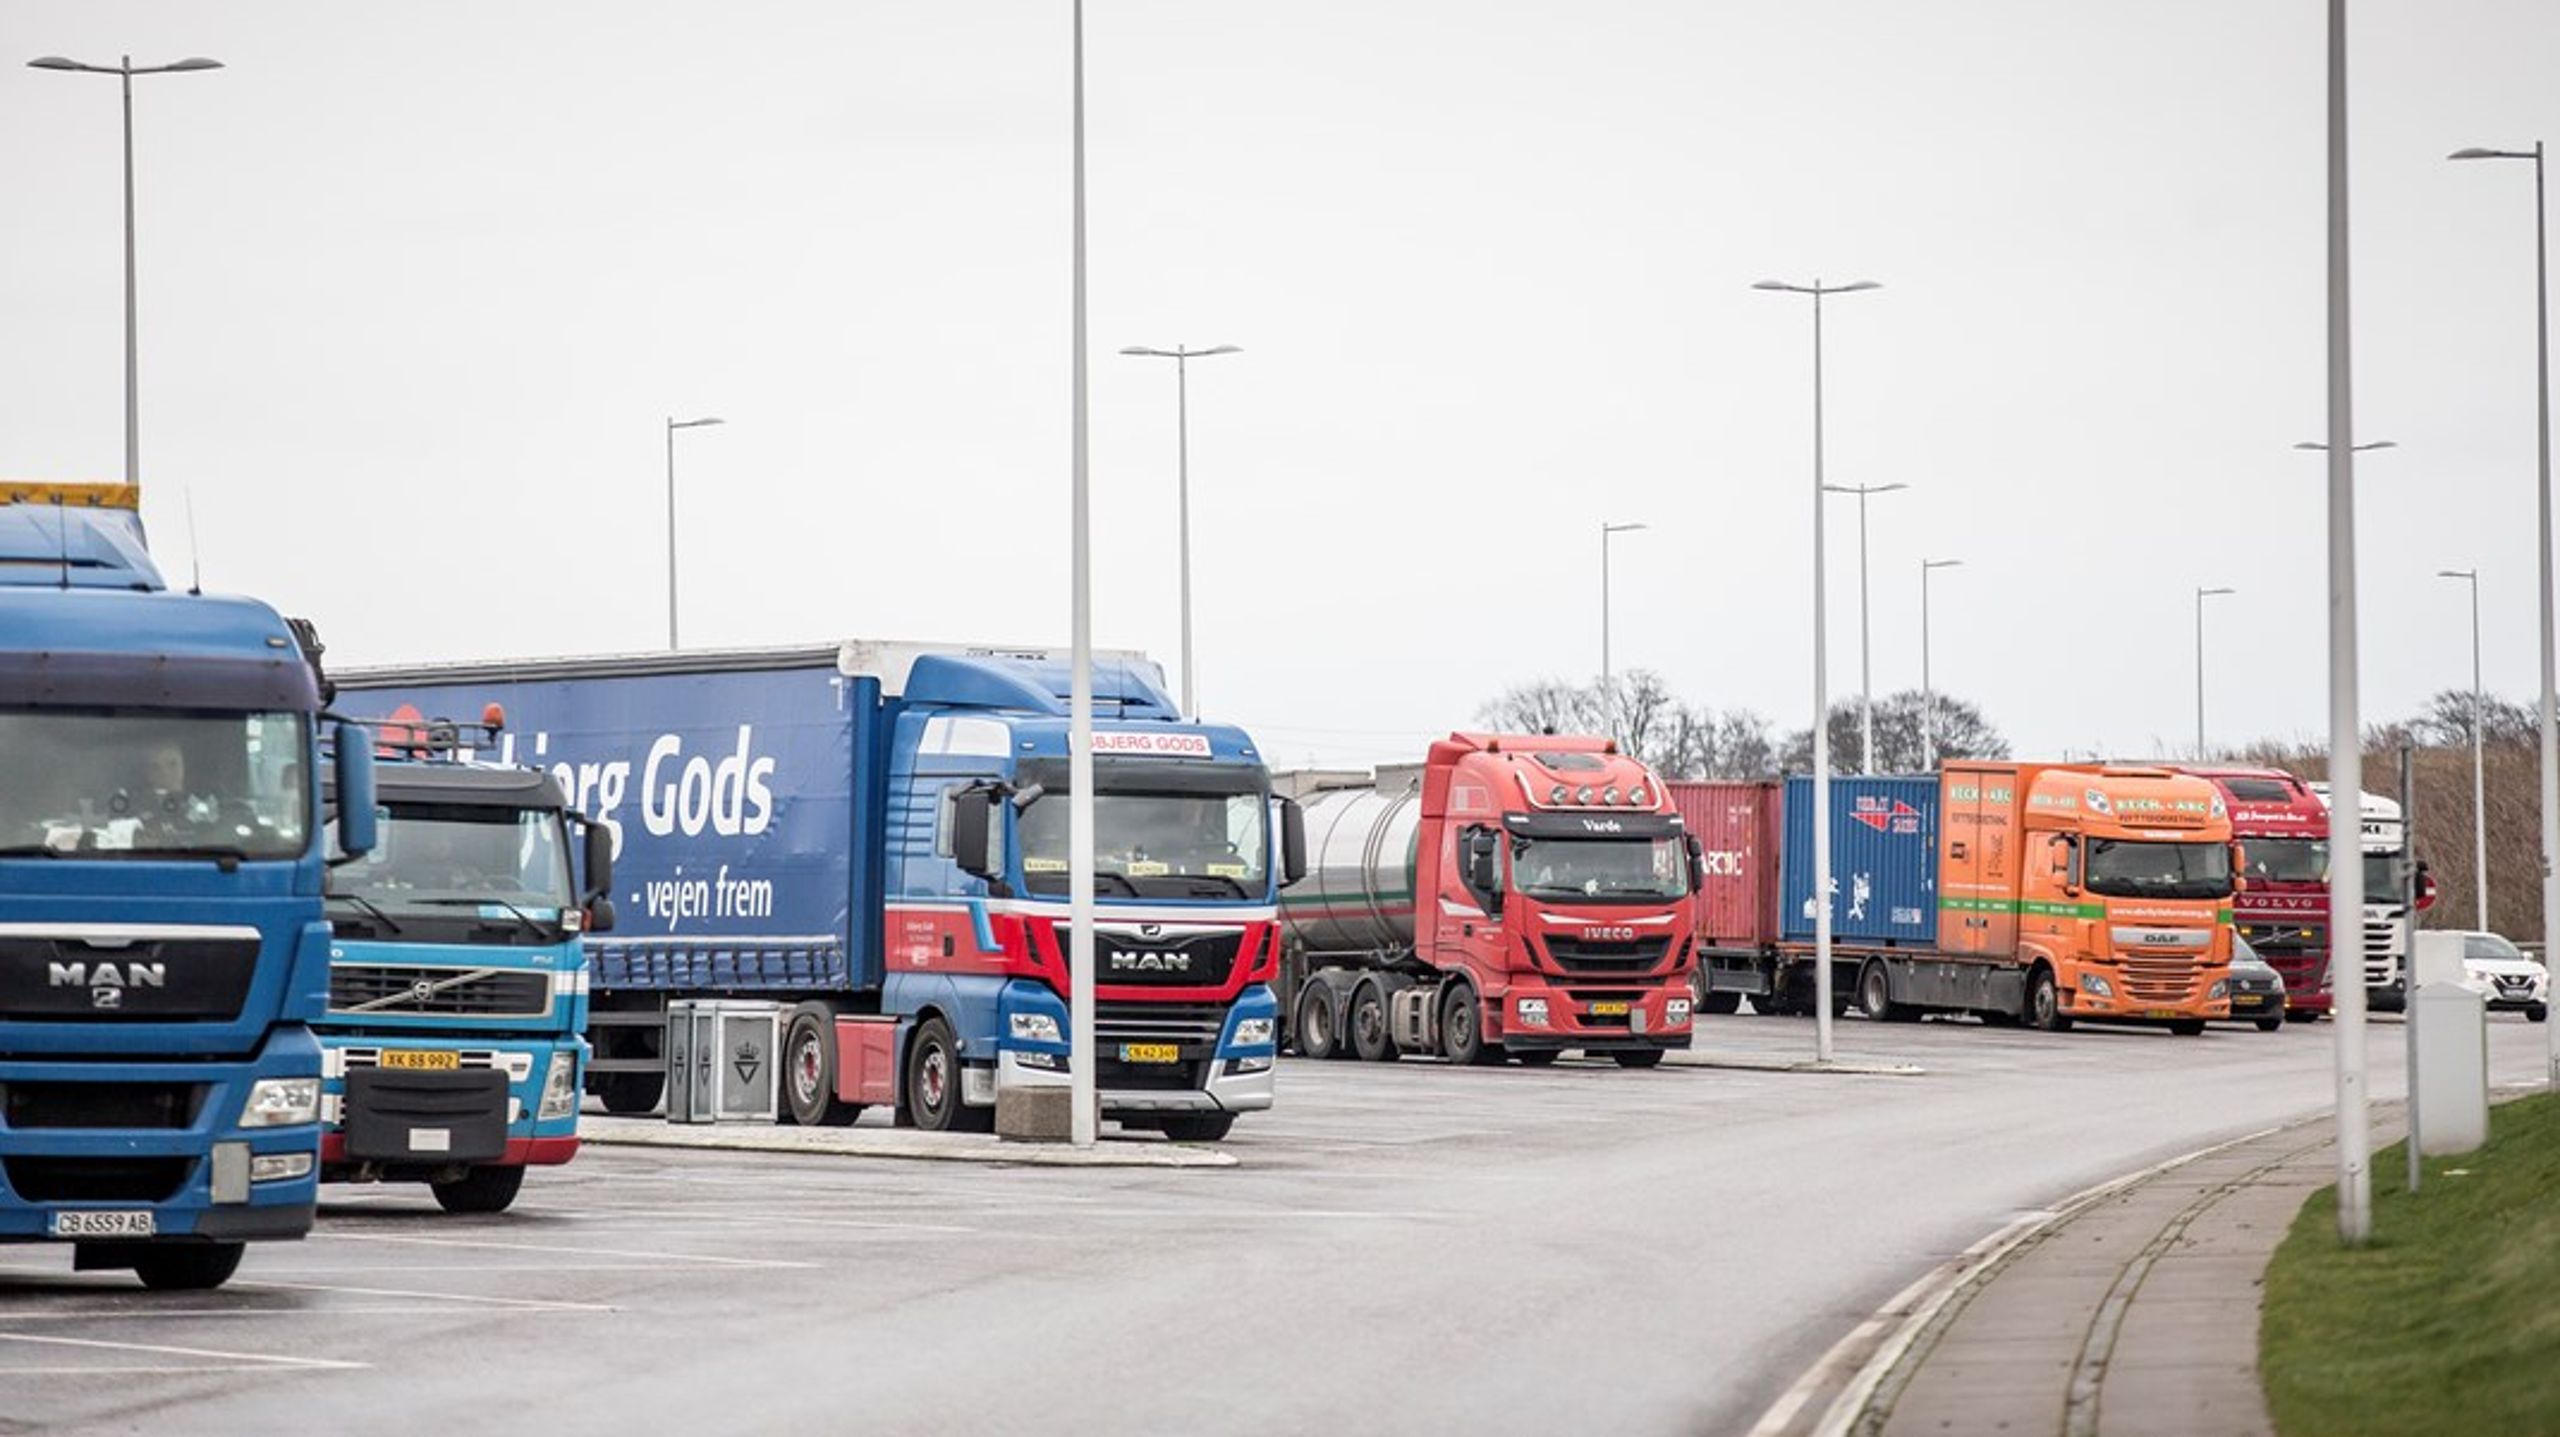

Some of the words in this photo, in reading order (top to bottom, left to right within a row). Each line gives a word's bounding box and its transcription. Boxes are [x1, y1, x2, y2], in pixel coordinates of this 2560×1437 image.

[1092, 735, 1152, 750] BJERG
[1157, 737, 1206, 752] GODS
[642, 724, 775, 836] Gods
[1583, 819, 1622, 833] Varde
[648, 866, 709, 931] vejen
[716, 865, 772, 917] frem
[2242, 898, 2313, 908] VOLVO
[1583, 927, 1634, 940] IVECO
[2144, 934, 2180, 943] DAF
[1111, 951, 1191, 970] MAN
[49, 962, 166, 987] MAN
[387, 1053, 404, 1067] XK
[408, 1054, 426, 1068] 88
[428, 1055, 453, 1069] 992
[60, 1214, 80, 1232] CB
[84, 1214, 125, 1232] 6559
[127, 1214, 149, 1232] AB
